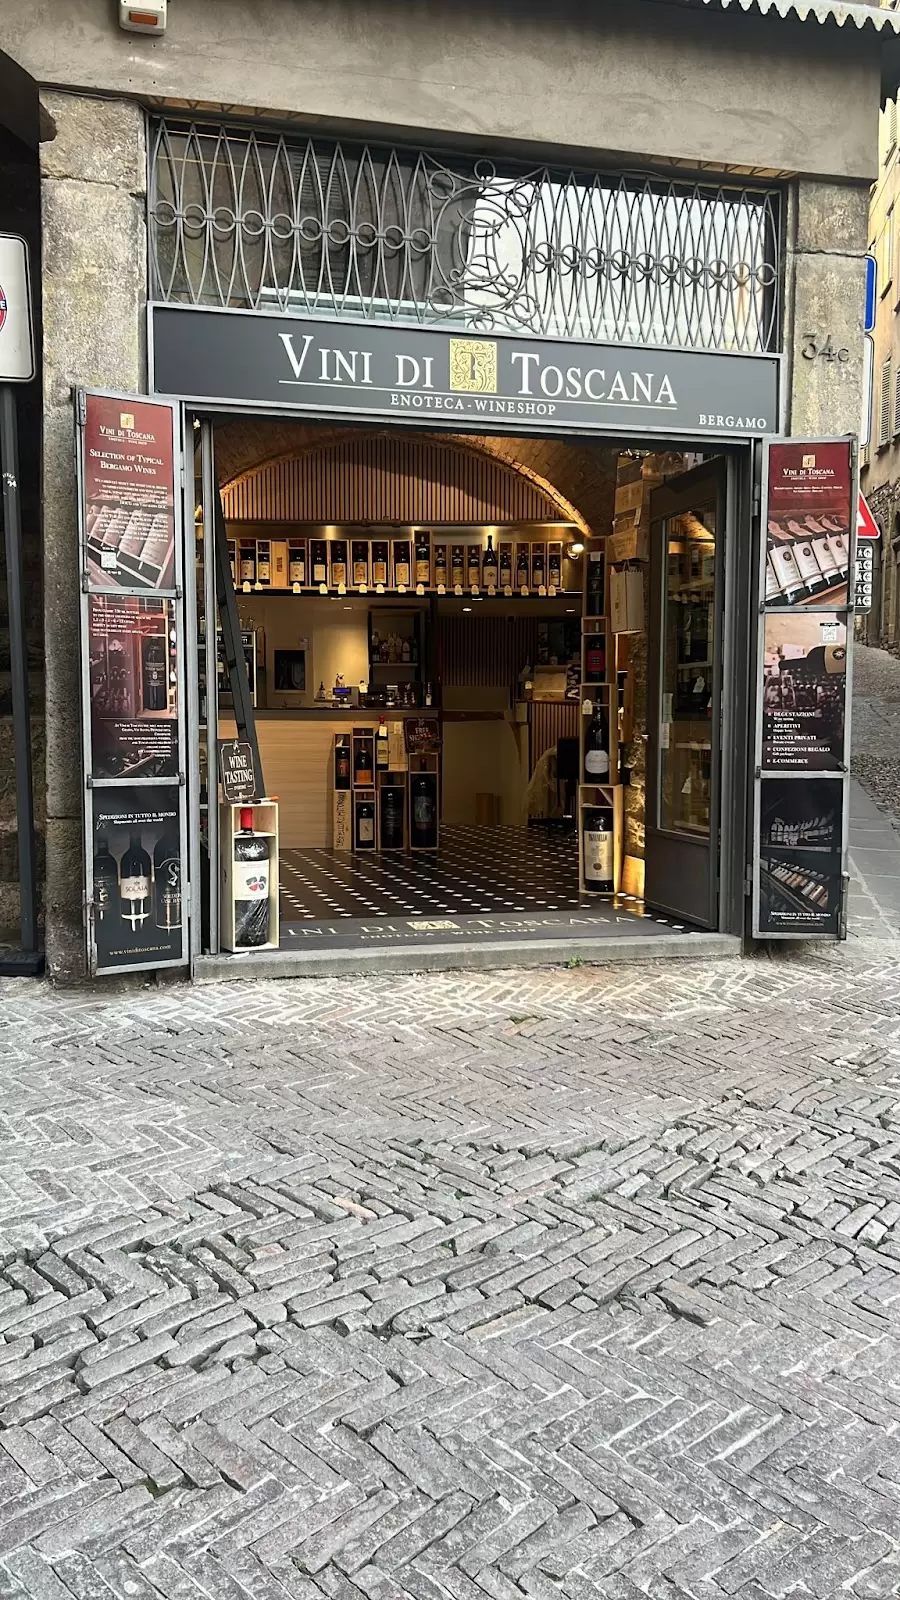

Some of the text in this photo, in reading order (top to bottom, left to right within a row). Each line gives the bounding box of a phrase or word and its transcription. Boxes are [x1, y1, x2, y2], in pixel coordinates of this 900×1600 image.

[278, 333, 373, 383] VINI
[395, 354, 434, 388] DI
[511, 352, 678, 404] TOSCANA
[698, 414, 767, 429] BERGAMO
[99, 425, 116, 436] VINI
[118, 429, 125, 437] DI
[127, 429, 156, 442] TOSCANA
[89, 448, 164, 466] SELECTION OF TYPICAL
[100, 460, 157, 475] BERGAMO WINES
[782, 468, 797, 476] VINI
[228, 755, 248, 769] WINE
[225, 769, 253, 784] TASTING
[125, 885, 148, 893] SOLAIA
[360, 925, 401, 933] DI
[466, 916, 636, 928] TOSCANA
